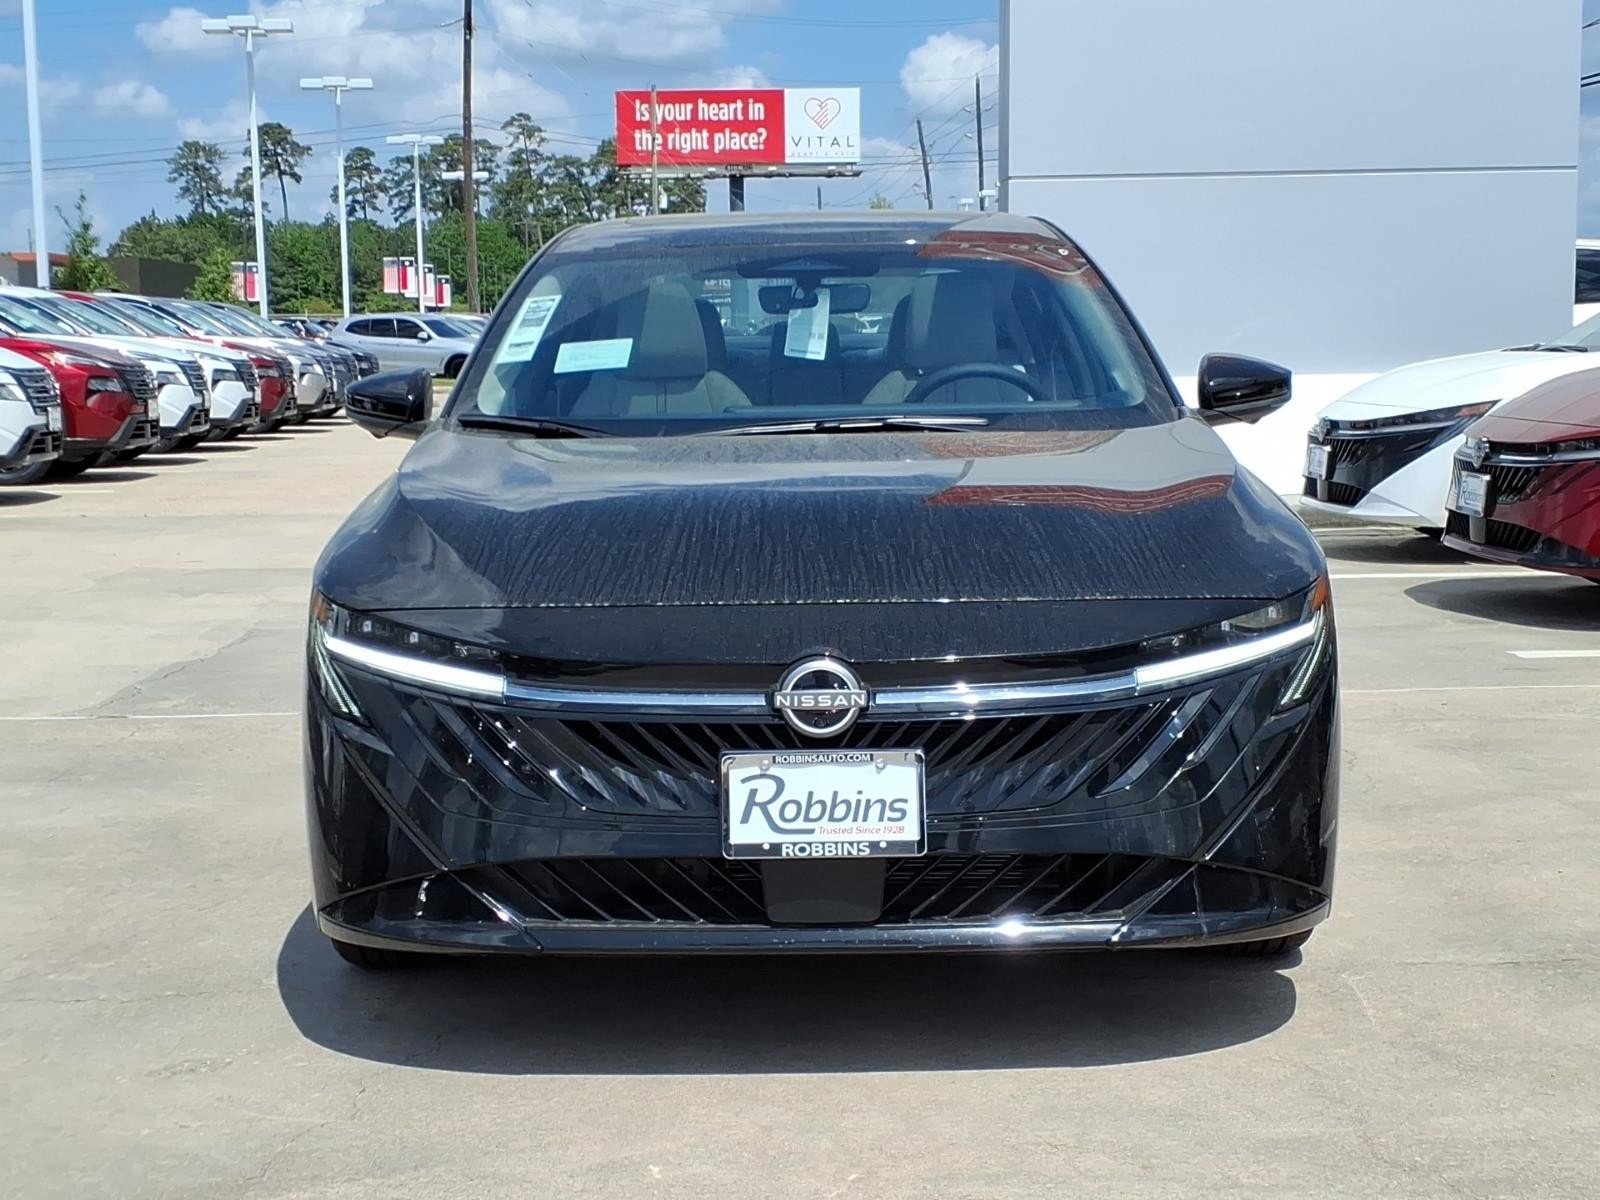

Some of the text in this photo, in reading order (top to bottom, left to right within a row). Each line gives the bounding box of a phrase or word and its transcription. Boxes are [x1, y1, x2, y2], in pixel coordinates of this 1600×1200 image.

[635, 98, 765, 124] Is your heart in
[634, 128, 767, 153] the right place?
[791, 135, 855, 148] VITAL
[776, 694, 865, 707] NISSAN
[775, 753, 871, 764] ROBBINSAUTO.COM
[740, 774, 908, 835] Robbins
[819, 825, 905, 835] Trusted Since 1928
[781, 842, 870, 857] ROBBINS
